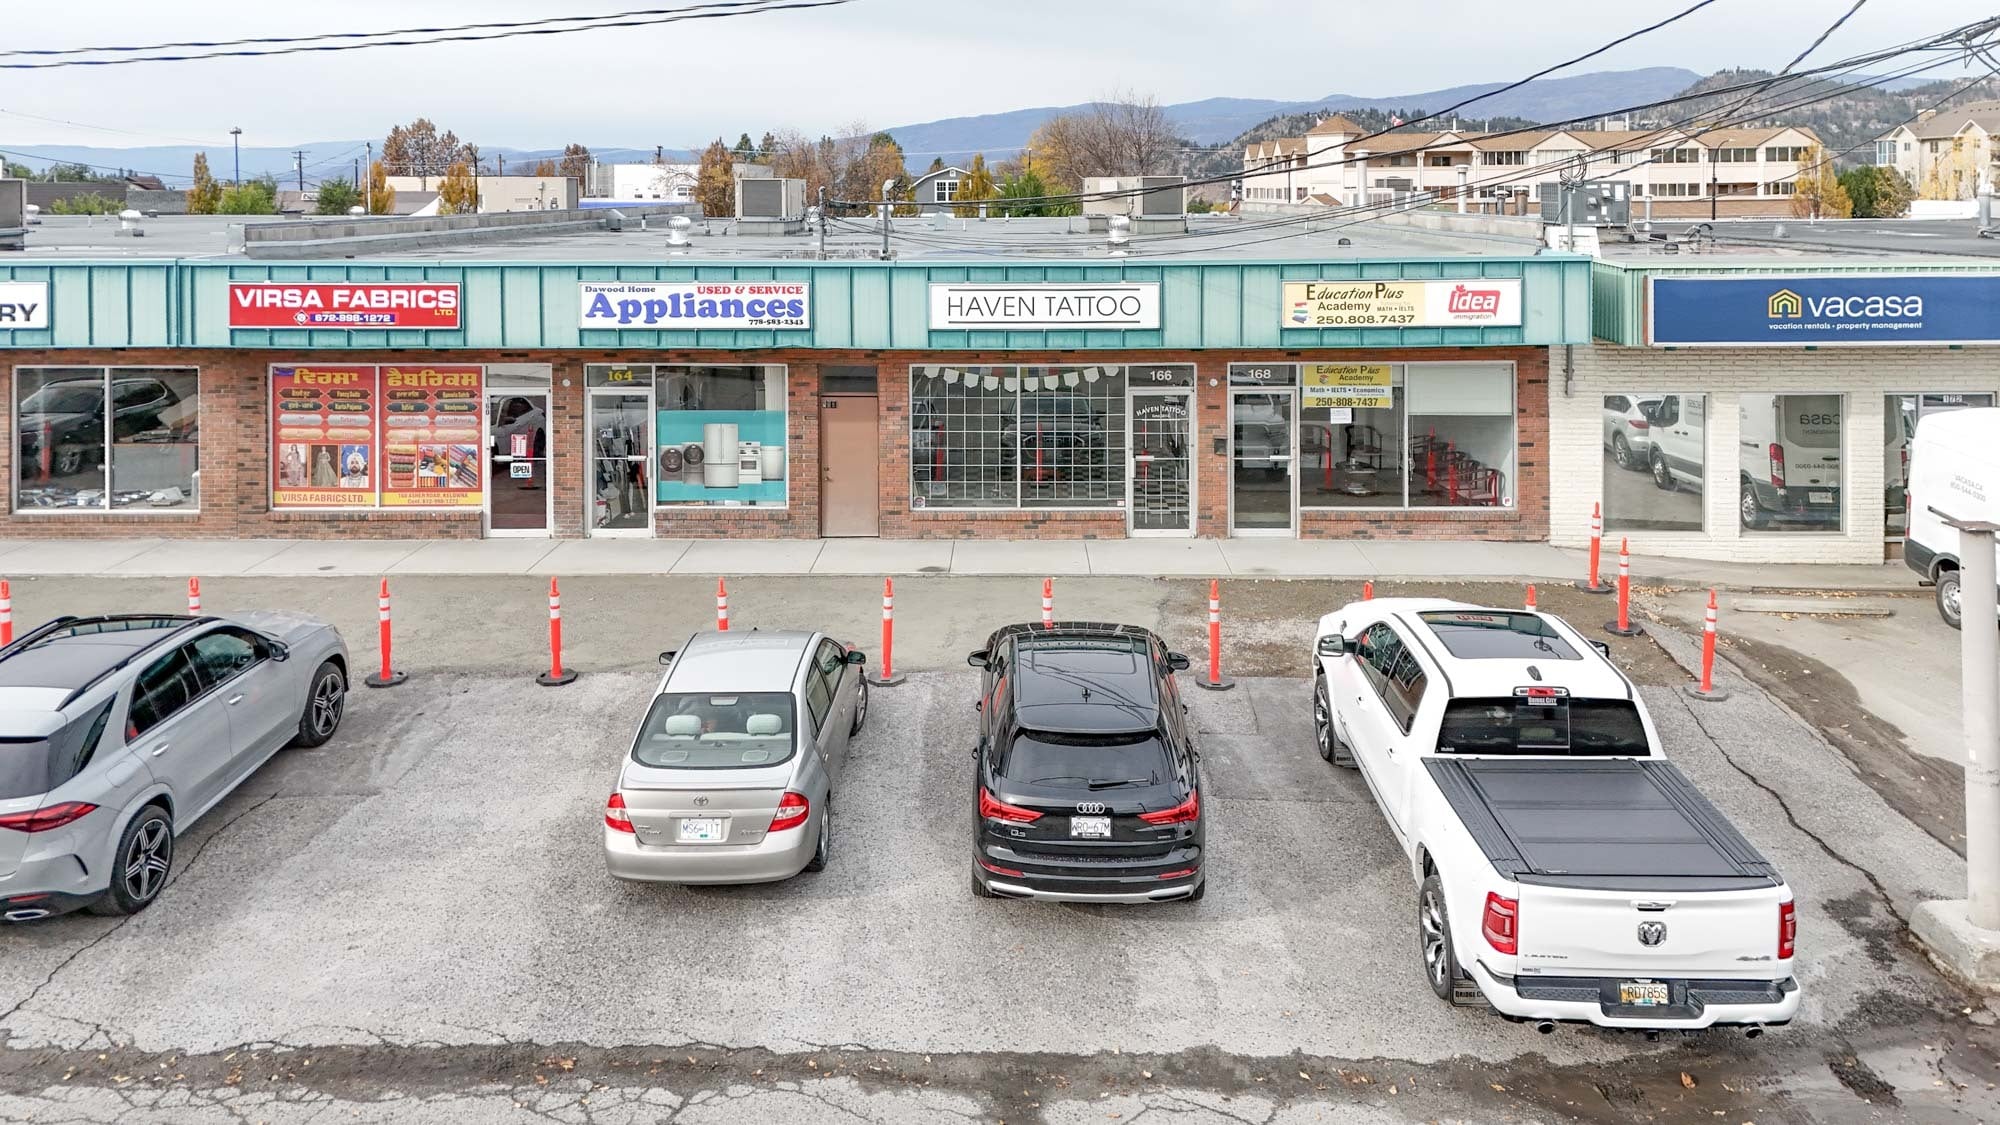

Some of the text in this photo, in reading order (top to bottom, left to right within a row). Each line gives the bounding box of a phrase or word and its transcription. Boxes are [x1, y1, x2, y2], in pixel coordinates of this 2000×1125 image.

[697, 286, 804, 295] USED & SERVICE
[1306, 283, 1404, 300] Education Plus
[234, 288, 457, 309] VIRSA FABRICS
[585, 292, 804, 324] Appliances
[947, 296, 1141, 317] HAVEN TATTOO
[1317, 302, 1371, 313] Academy
[1808, 296, 1923, 317] vacasa
[1316, 314, 1415, 325] 250.808.7437
[1836, 322, 1870, 331] property
[1871, 322, 1922, 330] management
[1247, 369, 1272, 380] 168
[1316, 365, 1357, 374] Education
[608, 370, 633, 382] 164
[1150, 370, 1172, 381] 166
[1339, 374, 1374, 382] Academy
[1316, 397, 1379, 407] 250-808-7437
[1136, 405, 1186, 417] HAVEN TATTOO
[513, 465, 530, 474] OPEN
[281, 493, 308, 502] VIRSA
[309, 494, 346, 503] FABRICS
